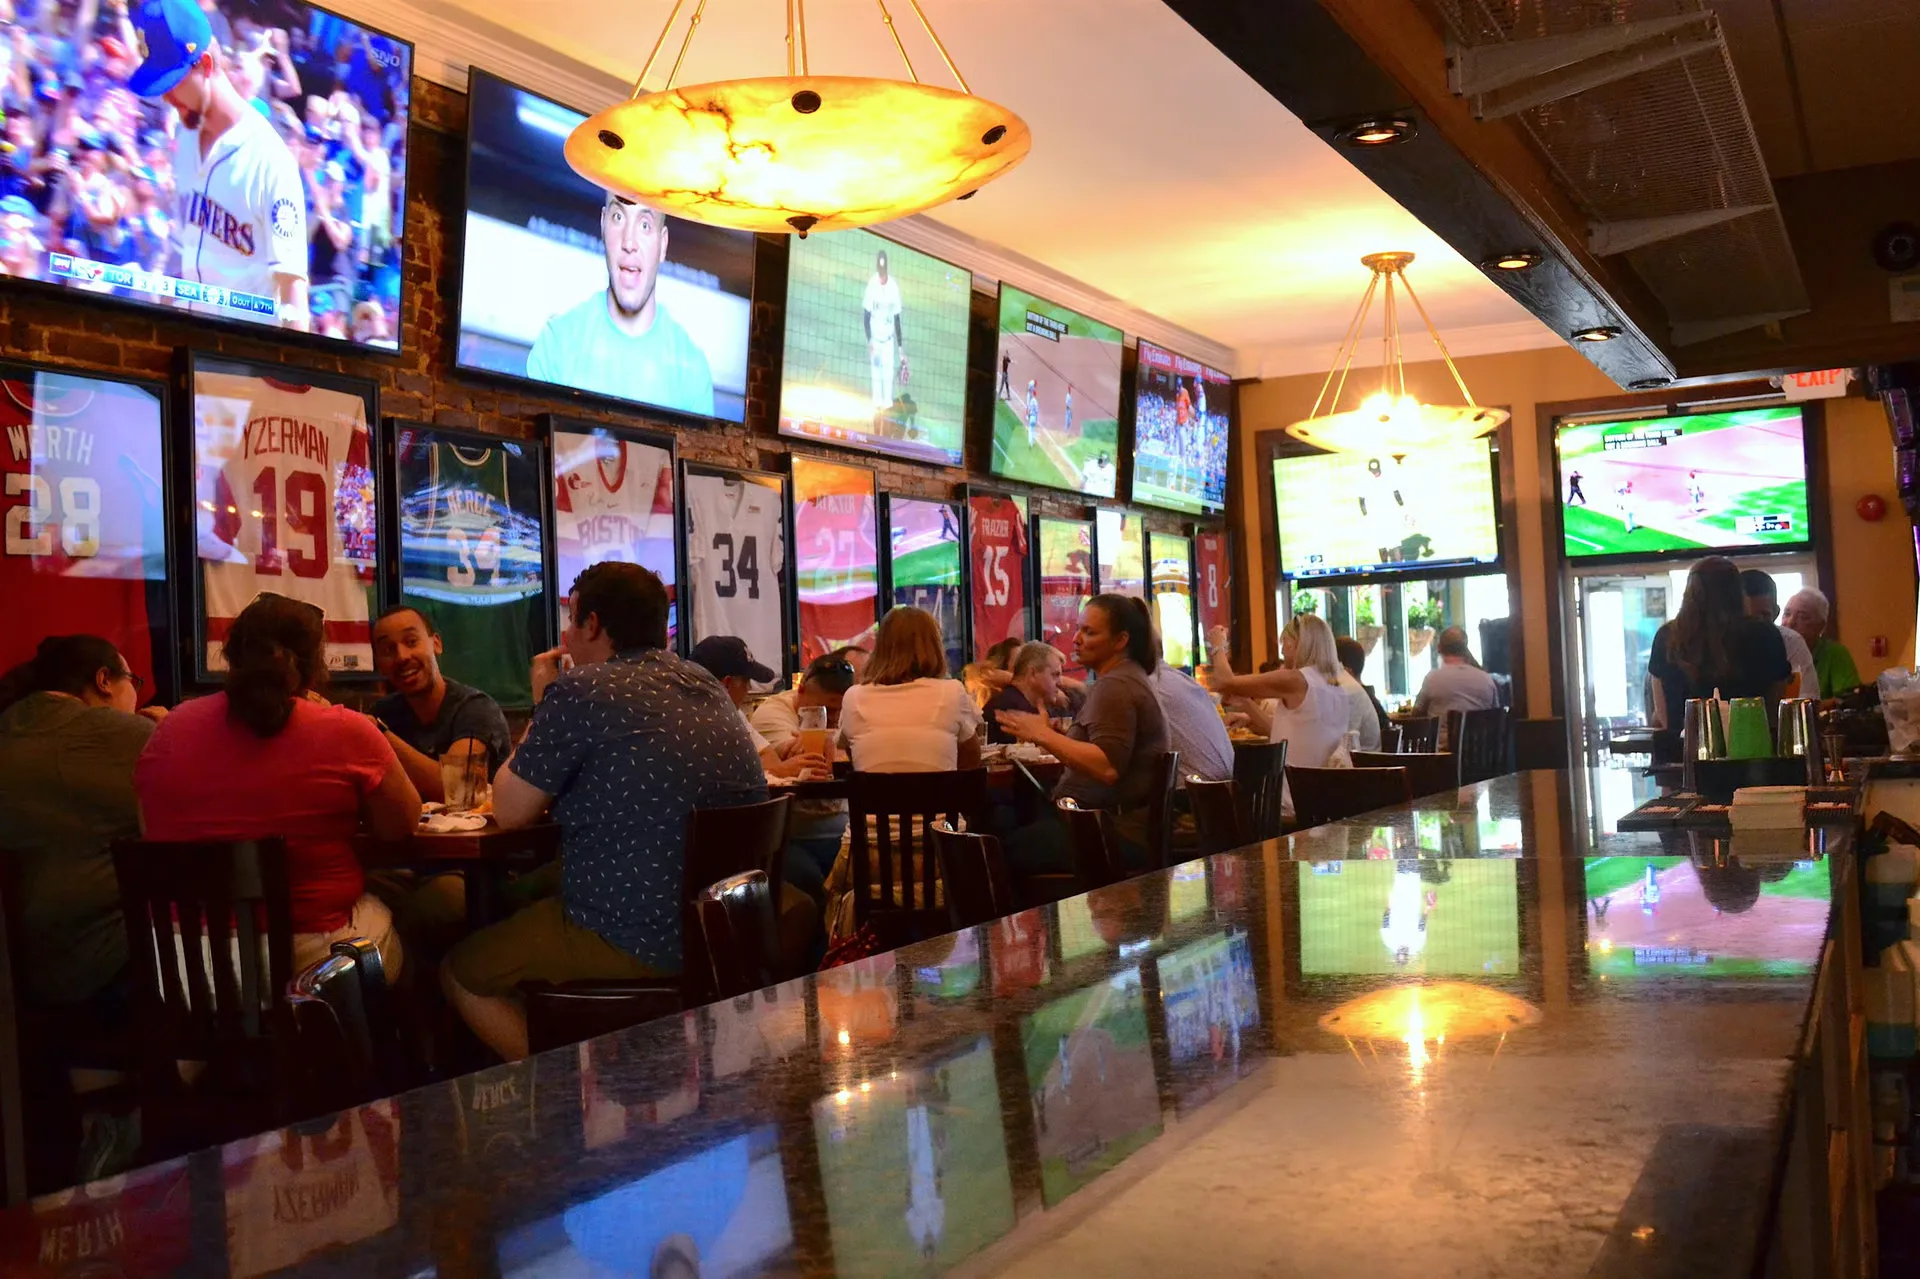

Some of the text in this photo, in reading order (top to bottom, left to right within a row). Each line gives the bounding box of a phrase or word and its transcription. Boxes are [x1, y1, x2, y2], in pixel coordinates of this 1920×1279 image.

[109, 270, 133, 285] TOR
[176, 284, 198, 298] SEA
[1797, 367, 1842, 387] EXIT
[7, 424, 94, 466] WERTH
[243, 416, 329, 471] YZERMAN
[5, 472, 101, 557] 28
[253, 466, 329, 580] 19
[981, 518, 1010, 538] FRAZIER
[447, 526, 500, 588] 34
[713, 532, 760, 600] 34
[983, 544, 1010, 607] 15
[1207, 563, 1219, 608] 8
